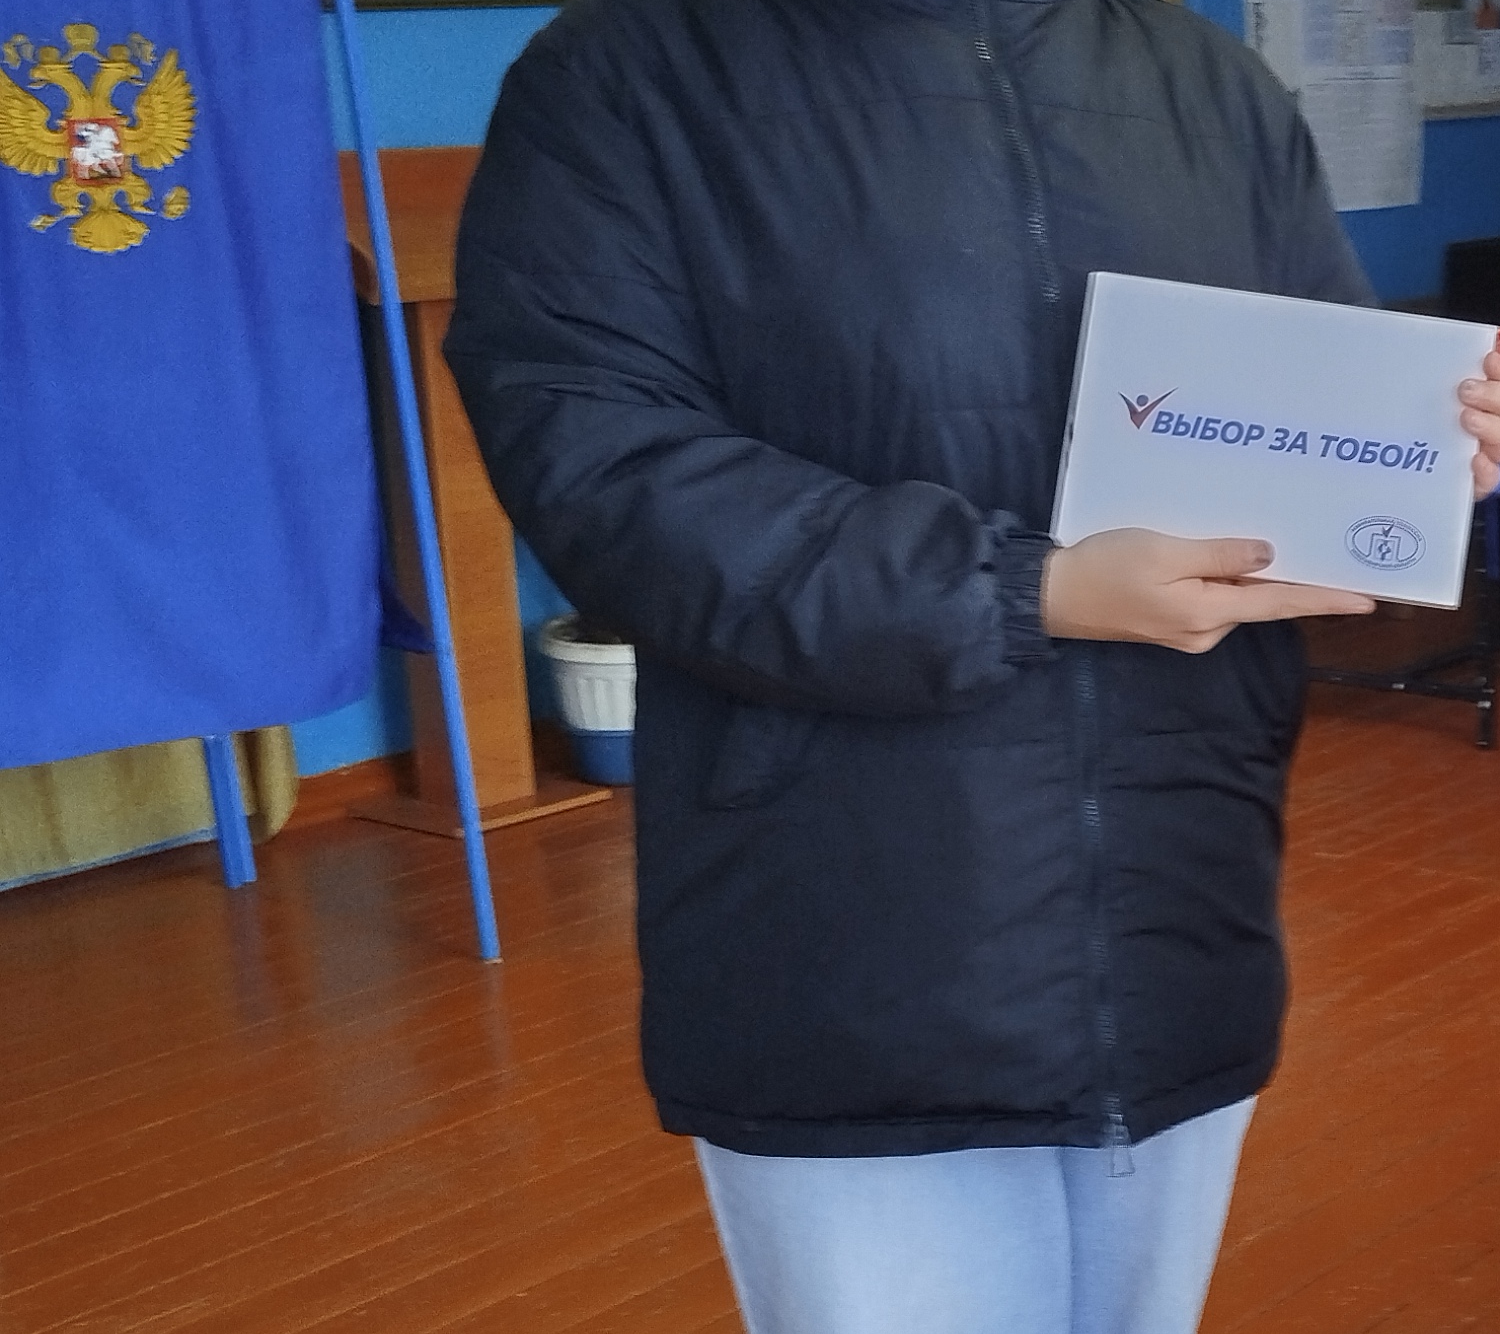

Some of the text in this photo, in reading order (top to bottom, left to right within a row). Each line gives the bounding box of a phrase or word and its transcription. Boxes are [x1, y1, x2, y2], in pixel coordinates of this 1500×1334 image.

[1151, 410, 1440, 474] ВЫБОР ЗА ТОБОЙ!
